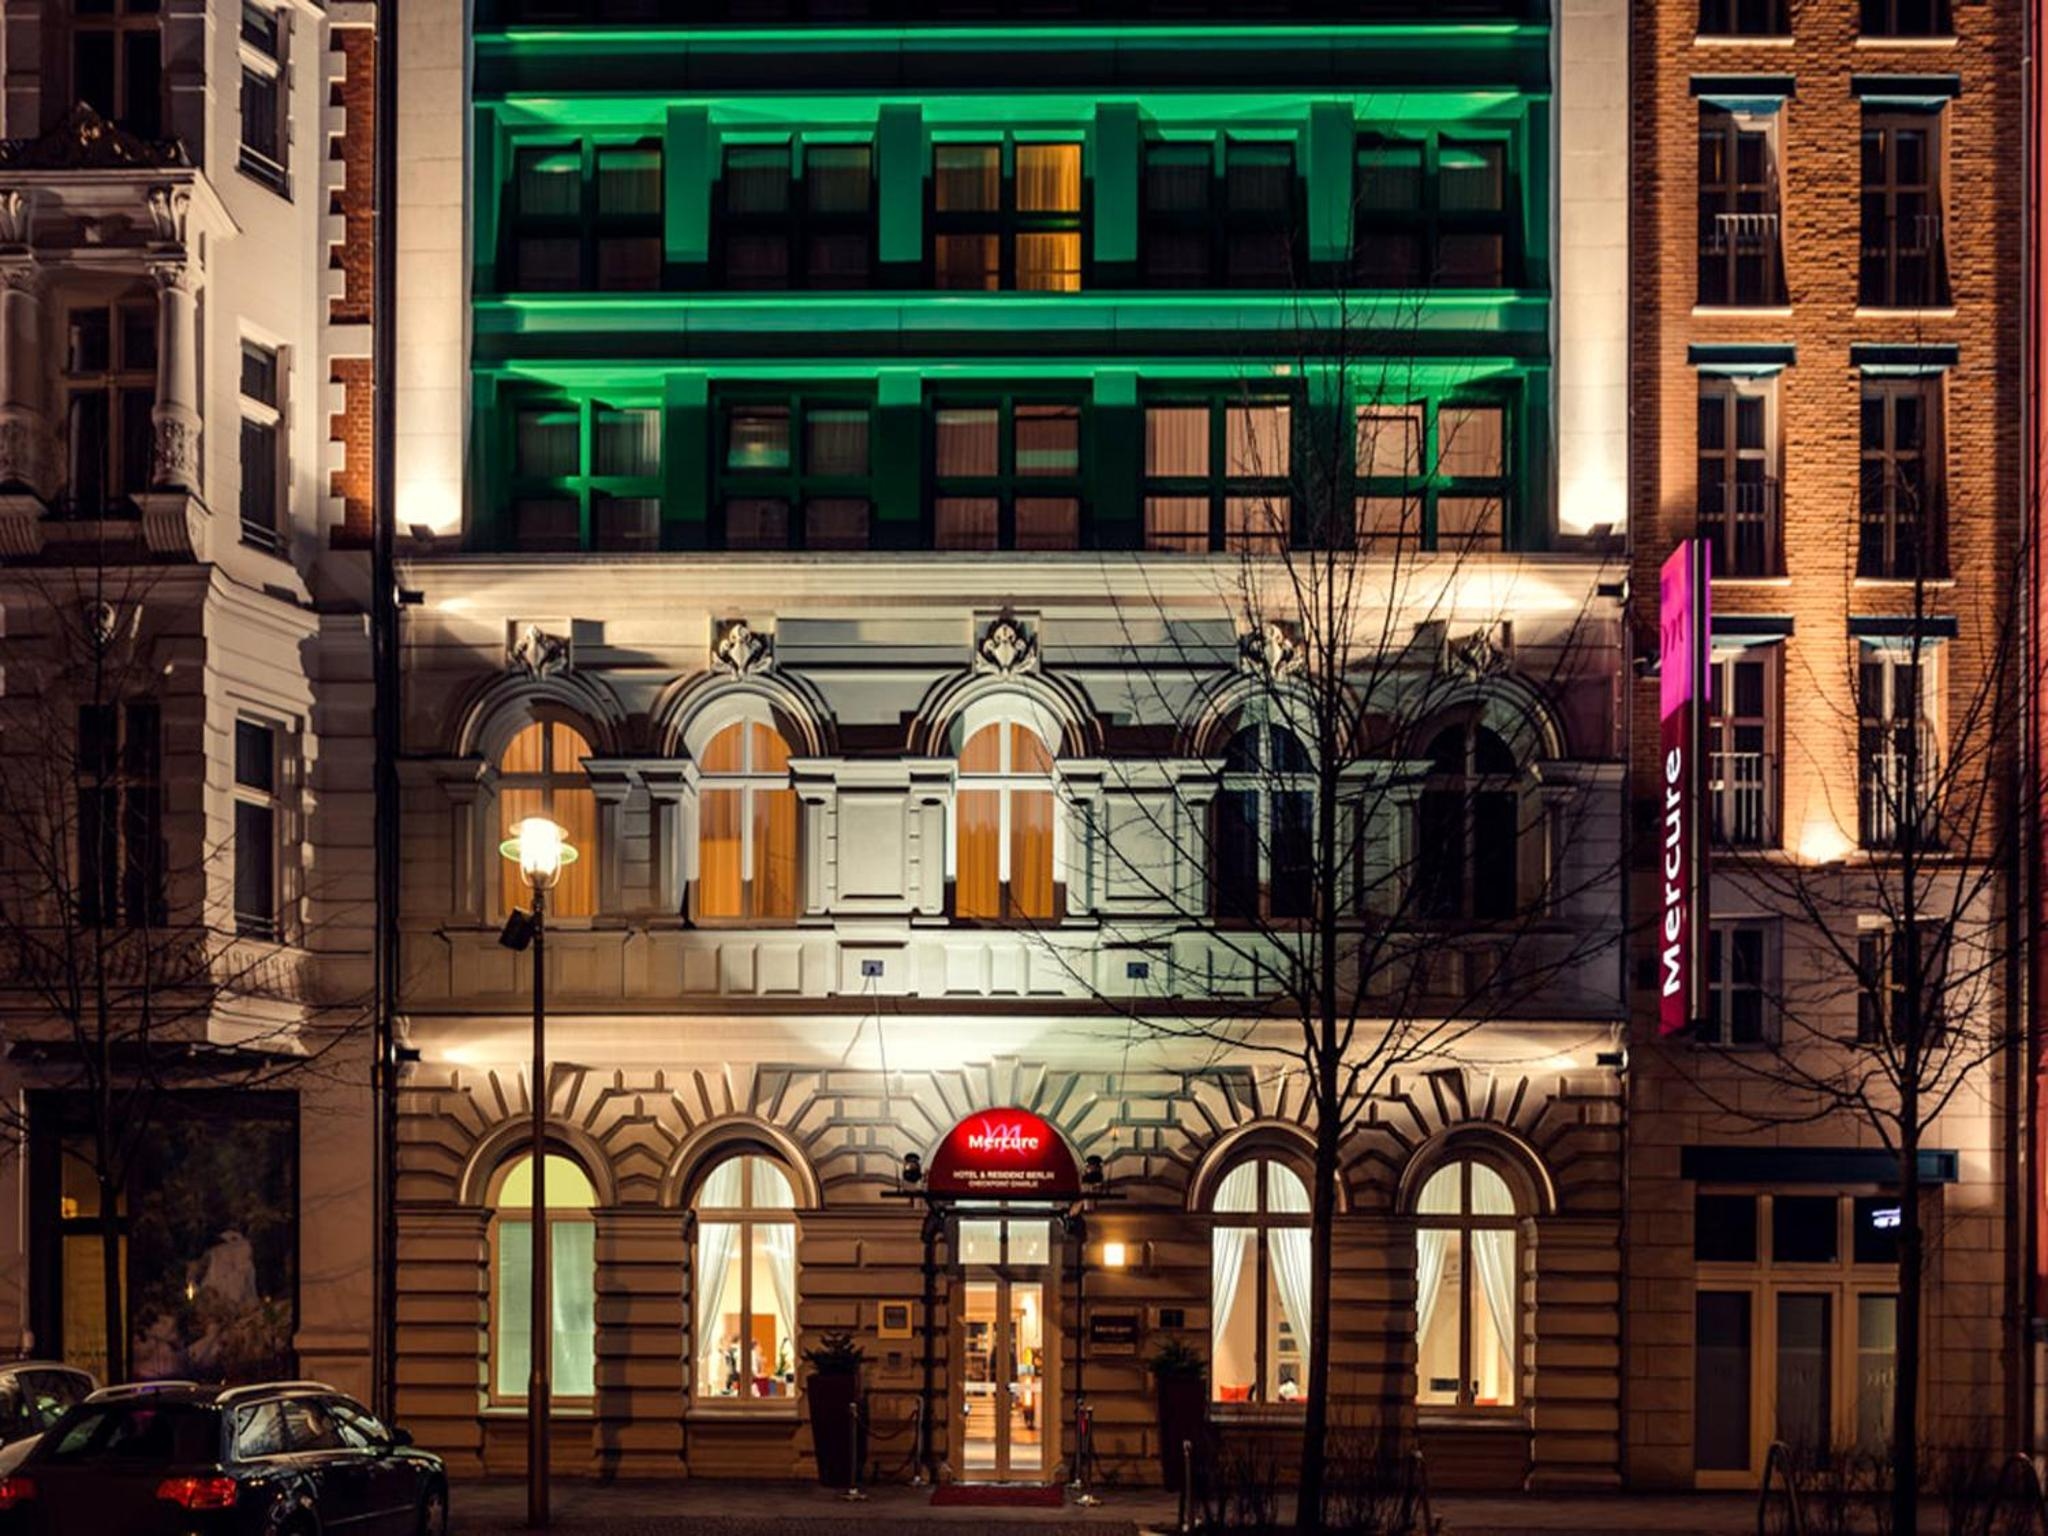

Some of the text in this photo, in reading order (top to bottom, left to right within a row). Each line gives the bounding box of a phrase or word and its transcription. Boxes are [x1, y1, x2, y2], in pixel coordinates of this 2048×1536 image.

[1662, 747, 1681, 997] Mercure
[968, 1135, 1039, 1149] Mercure
[953, 1171, 977, 1179] HOTEL
[1026, 1172, 1055, 1180] BERLIN
